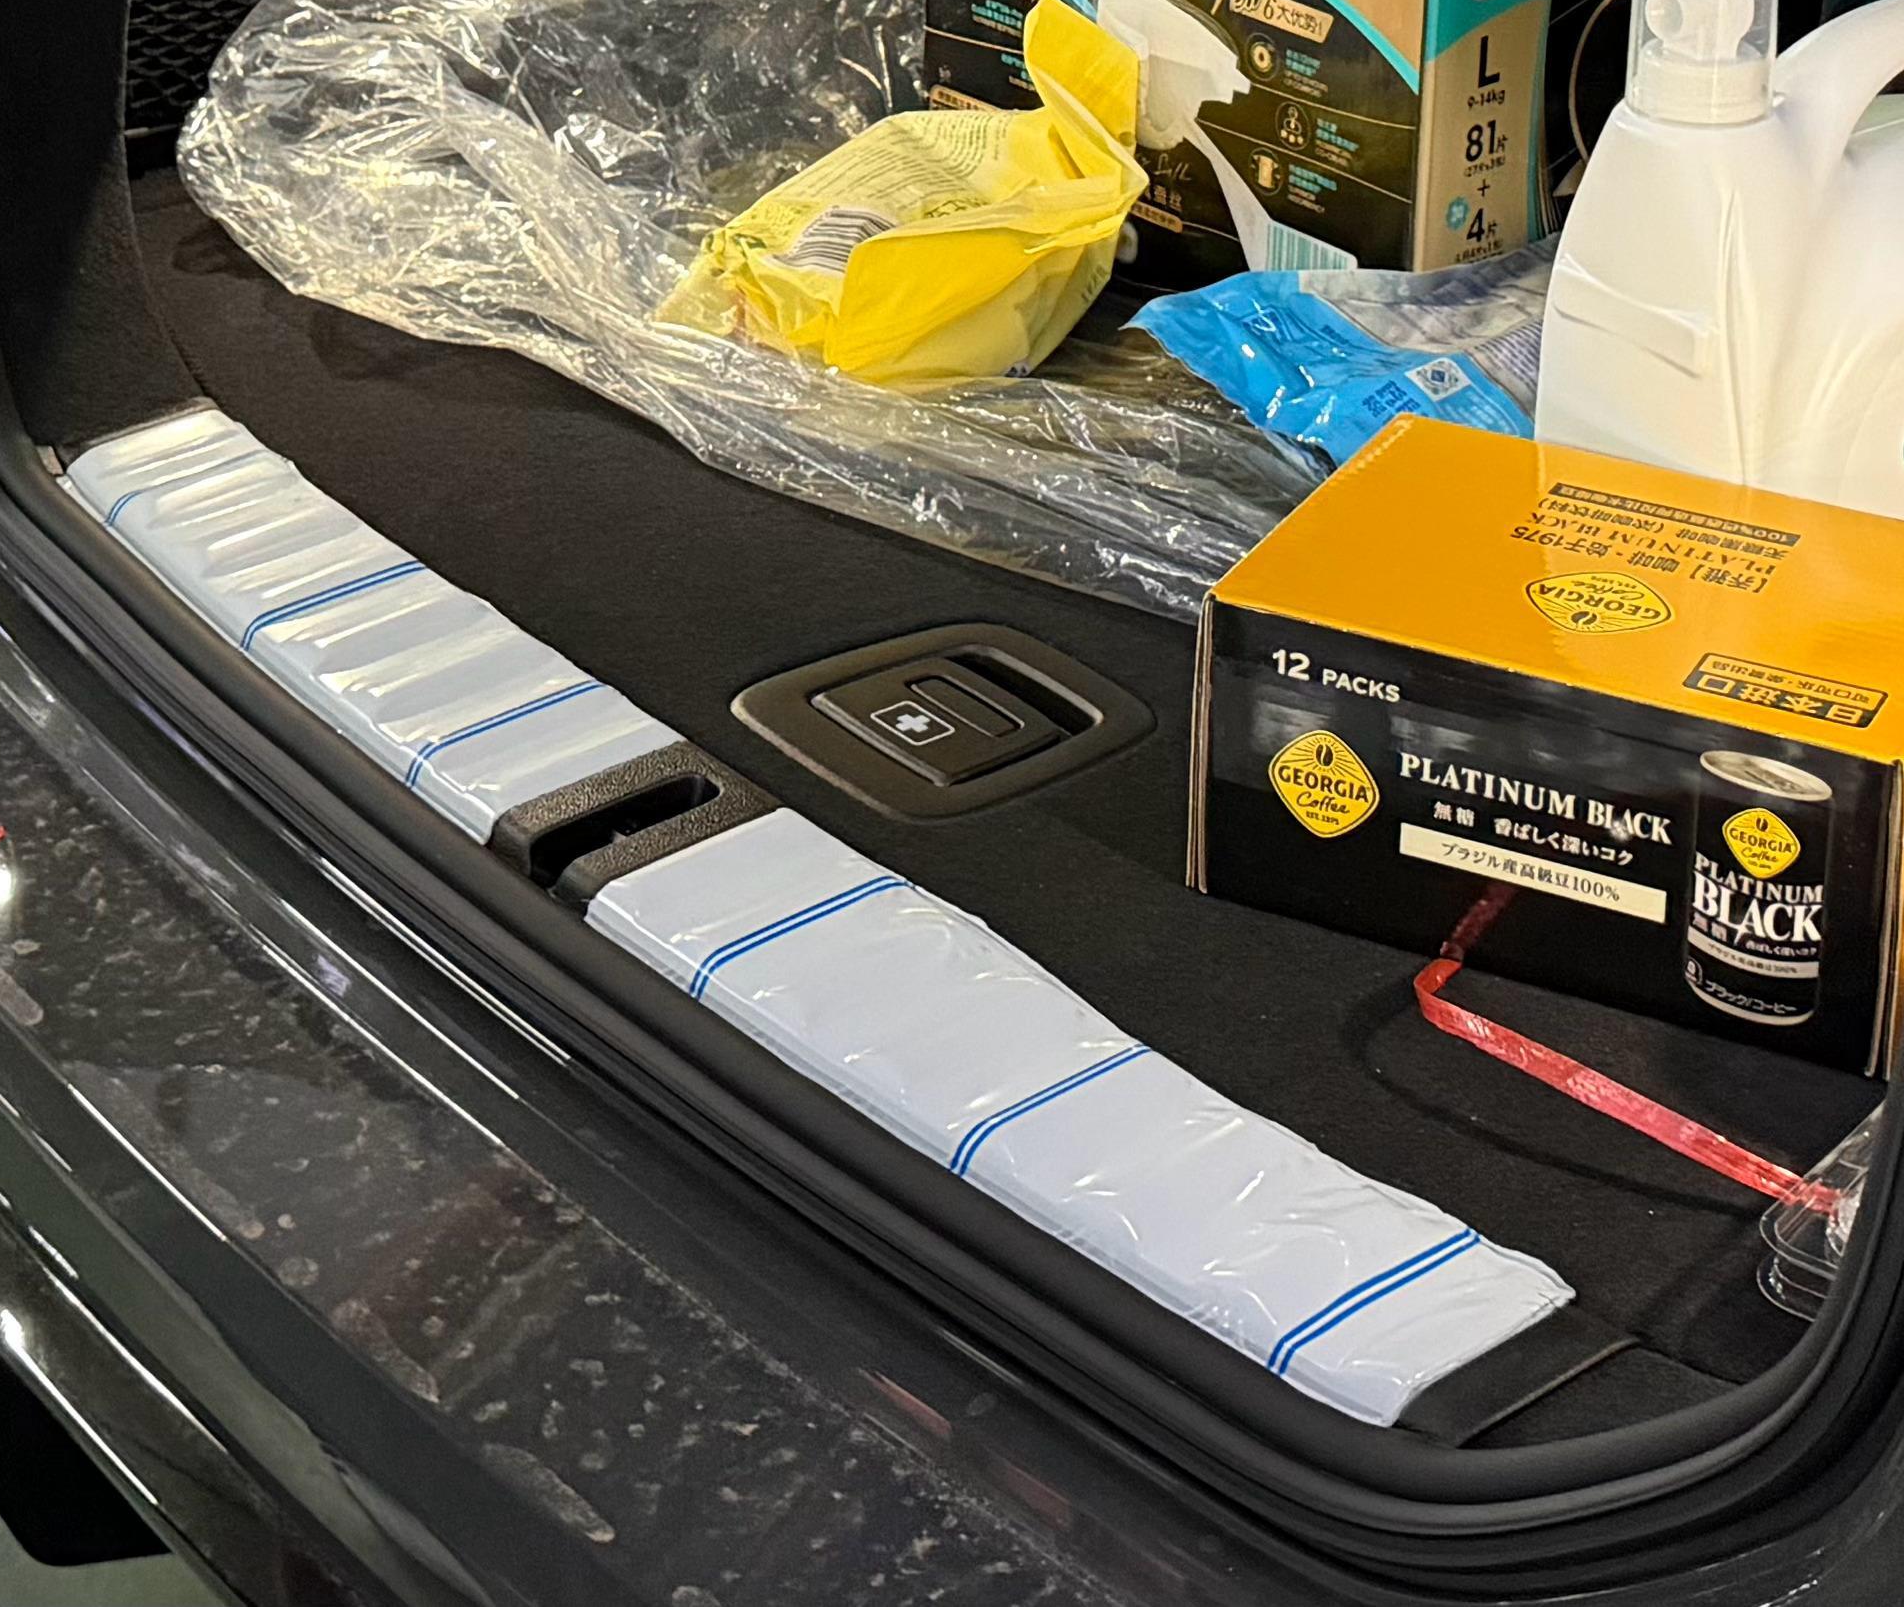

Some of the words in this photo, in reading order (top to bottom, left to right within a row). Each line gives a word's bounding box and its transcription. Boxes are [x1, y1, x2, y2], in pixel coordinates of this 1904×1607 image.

[1478, 35, 1500, 88] L
[1528, 511, 1600, 536] BLACK
[1608, 530, 1776, 576] PLATINUM
[1538, 583, 1661, 621] GEORGIA
[1272, 649, 1310, 681] 12
[1322, 668, 1400, 703] PACKS
[1697, 674, 1864, 724] 日本进口
[1278, 764, 1369, 804] GEORGIA
[1296, 791, 1350, 814] Coffee
[1399, 752, 1576, 819] PLATINUM
[1587, 799, 1673, 845] BLACK
[1433, 801, 1476, 827] 無糖
[1729, 827, 1793, 854] GEORGIA
[1695, 850, 1824, 904] PLATINUM
[1692, 871, 1823, 944] BLACK
